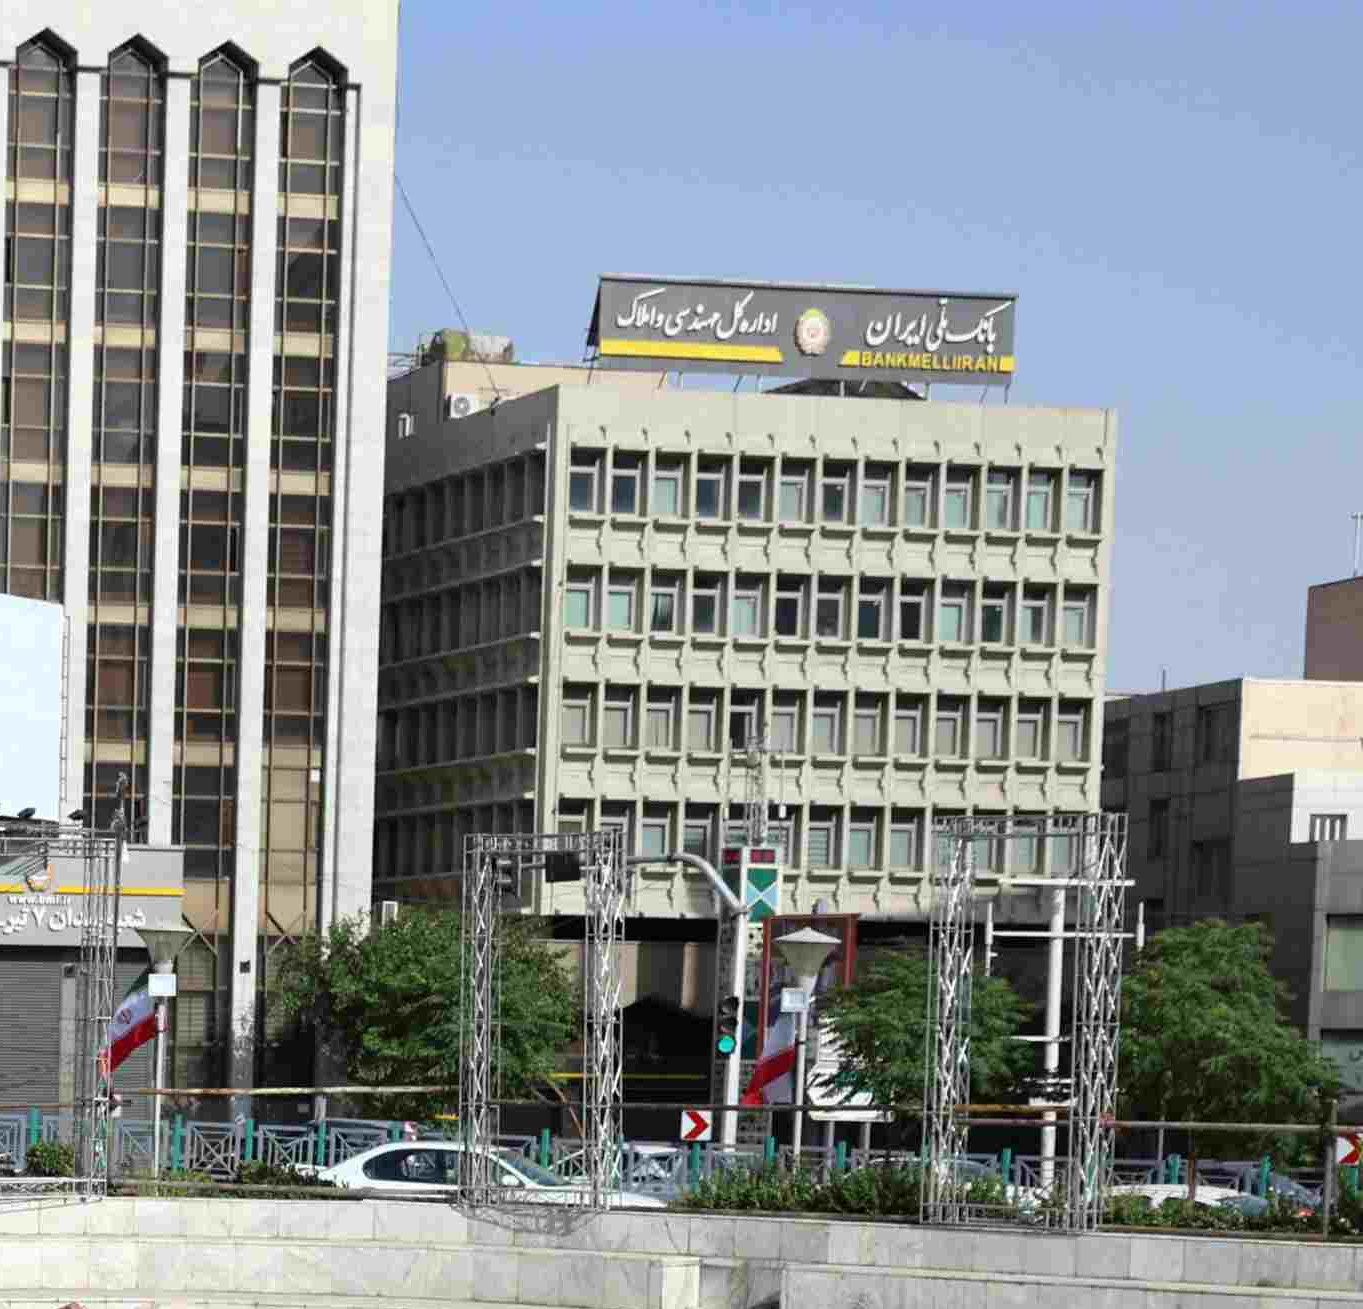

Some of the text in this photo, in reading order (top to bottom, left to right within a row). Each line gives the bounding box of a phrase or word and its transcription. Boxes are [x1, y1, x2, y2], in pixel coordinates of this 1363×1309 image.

[663, 303, 722, 337] مهندسی
[738, 311, 779, 334] اداره
[865, 310, 927, 347] ایران
[944, 300, 1012, 354] بانک
